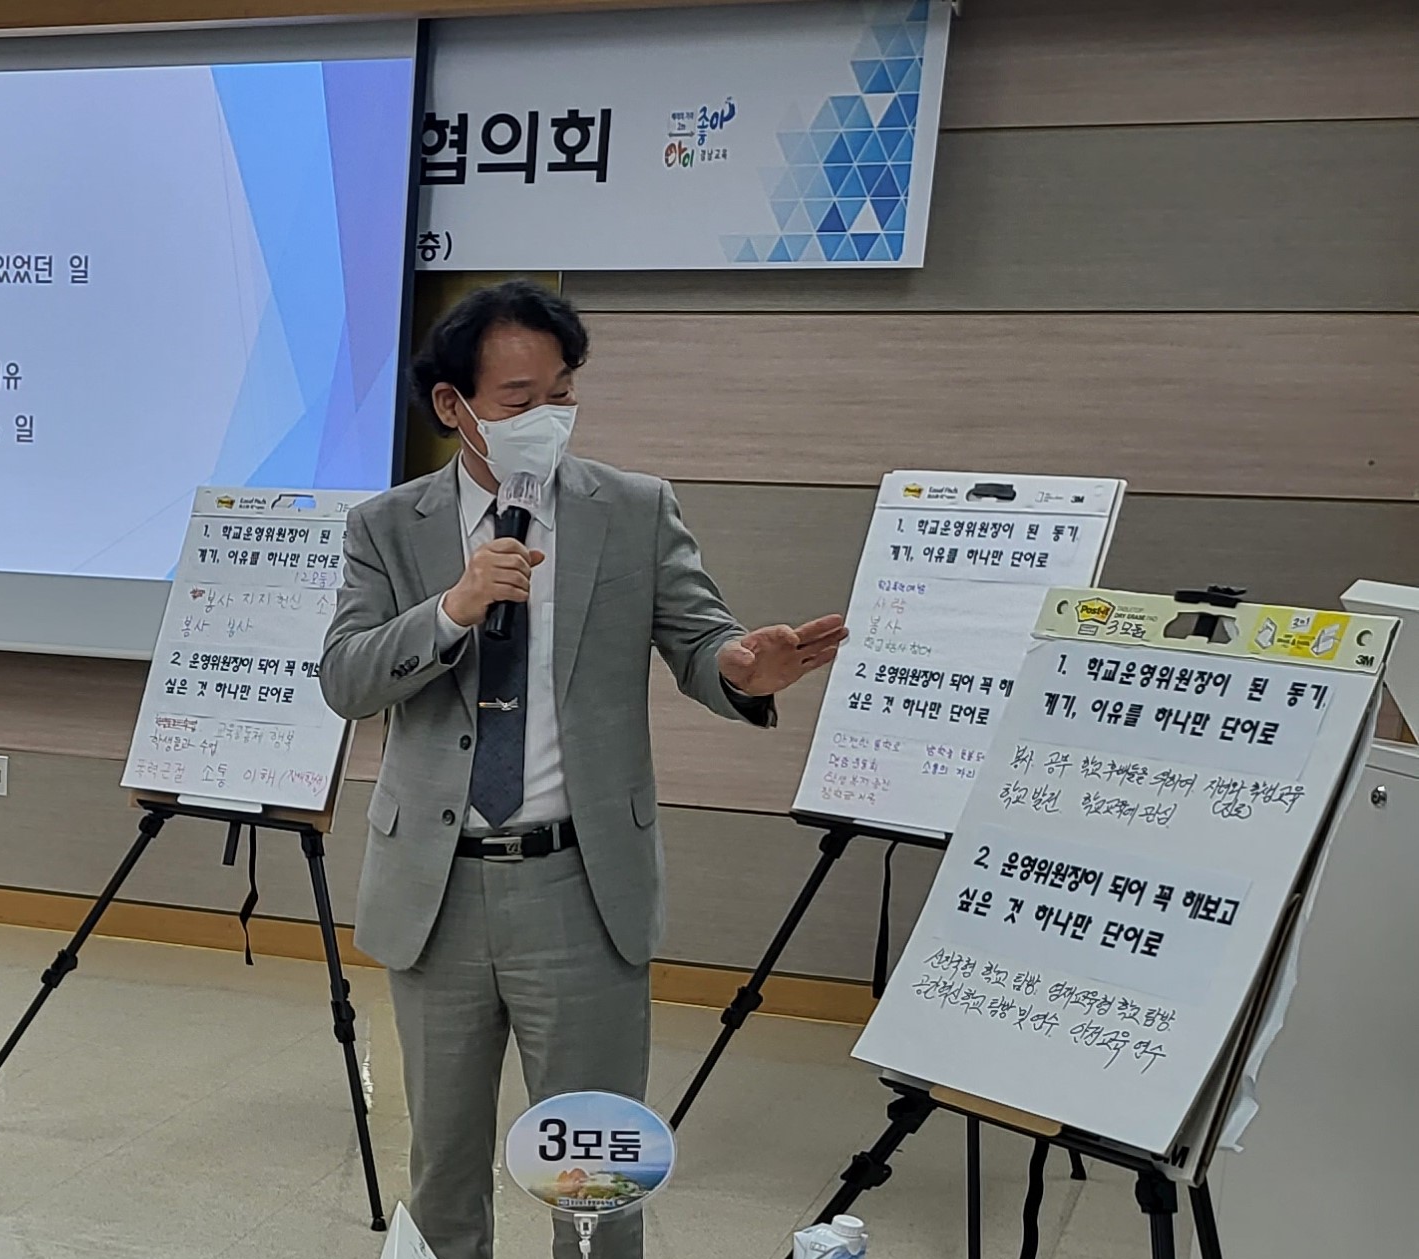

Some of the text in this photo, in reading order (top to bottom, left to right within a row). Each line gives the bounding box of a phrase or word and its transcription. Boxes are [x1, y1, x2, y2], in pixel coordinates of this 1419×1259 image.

[419, 108, 612, 184] 협의회
[70, 255, 89, 284] 일
[15, 415, 34, 443] 일
[222, 526, 309, 542] 학교운영위원장이
[320, 530, 330, 544] 된
[918, 520, 1014, 539] 학교운영위원장이
[1026, 525, 1038, 540] 된
[228, 550, 260, 565] 이유를
[267, 552, 300, 567] 하나만
[307, 554, 340, 568] 단어로
[923, 548, 958, 563] 이유를
[967, 549, 1003, 566] 하나만
[1010, 552, 1048, 568] 단어로
[1080, 605, 1110, 616] Post-it
[189, 653, 295, 677] 운영위원장이 되어 꼭
[1356, 655, 1373, 667] 3M
[165, 678, 294, 703] 싶은 것 하나만 단어로
[875, 665, 992, 694] 운영위원장이 되어 꼭
[1058, 654, 1269, 702] 1. 학교운영위원장이 된
[848, 693, 990, 725] 싶은 것 하나만 단어로
[1044, 692, 1279, 745] 계기, 이유를 하나만 단어로
[1000, 851, 1104, 897] 운영위원장이
[1108, 874, 1148, 907] 되어
[1154, 883, 1175, 913] 꼭
[1181, 889, 1240, 927] 해보고
[957, 887, 1164, 958] 싶은 것 하나만 단어로
[538, 1118, 641, 1163] 3모둠
